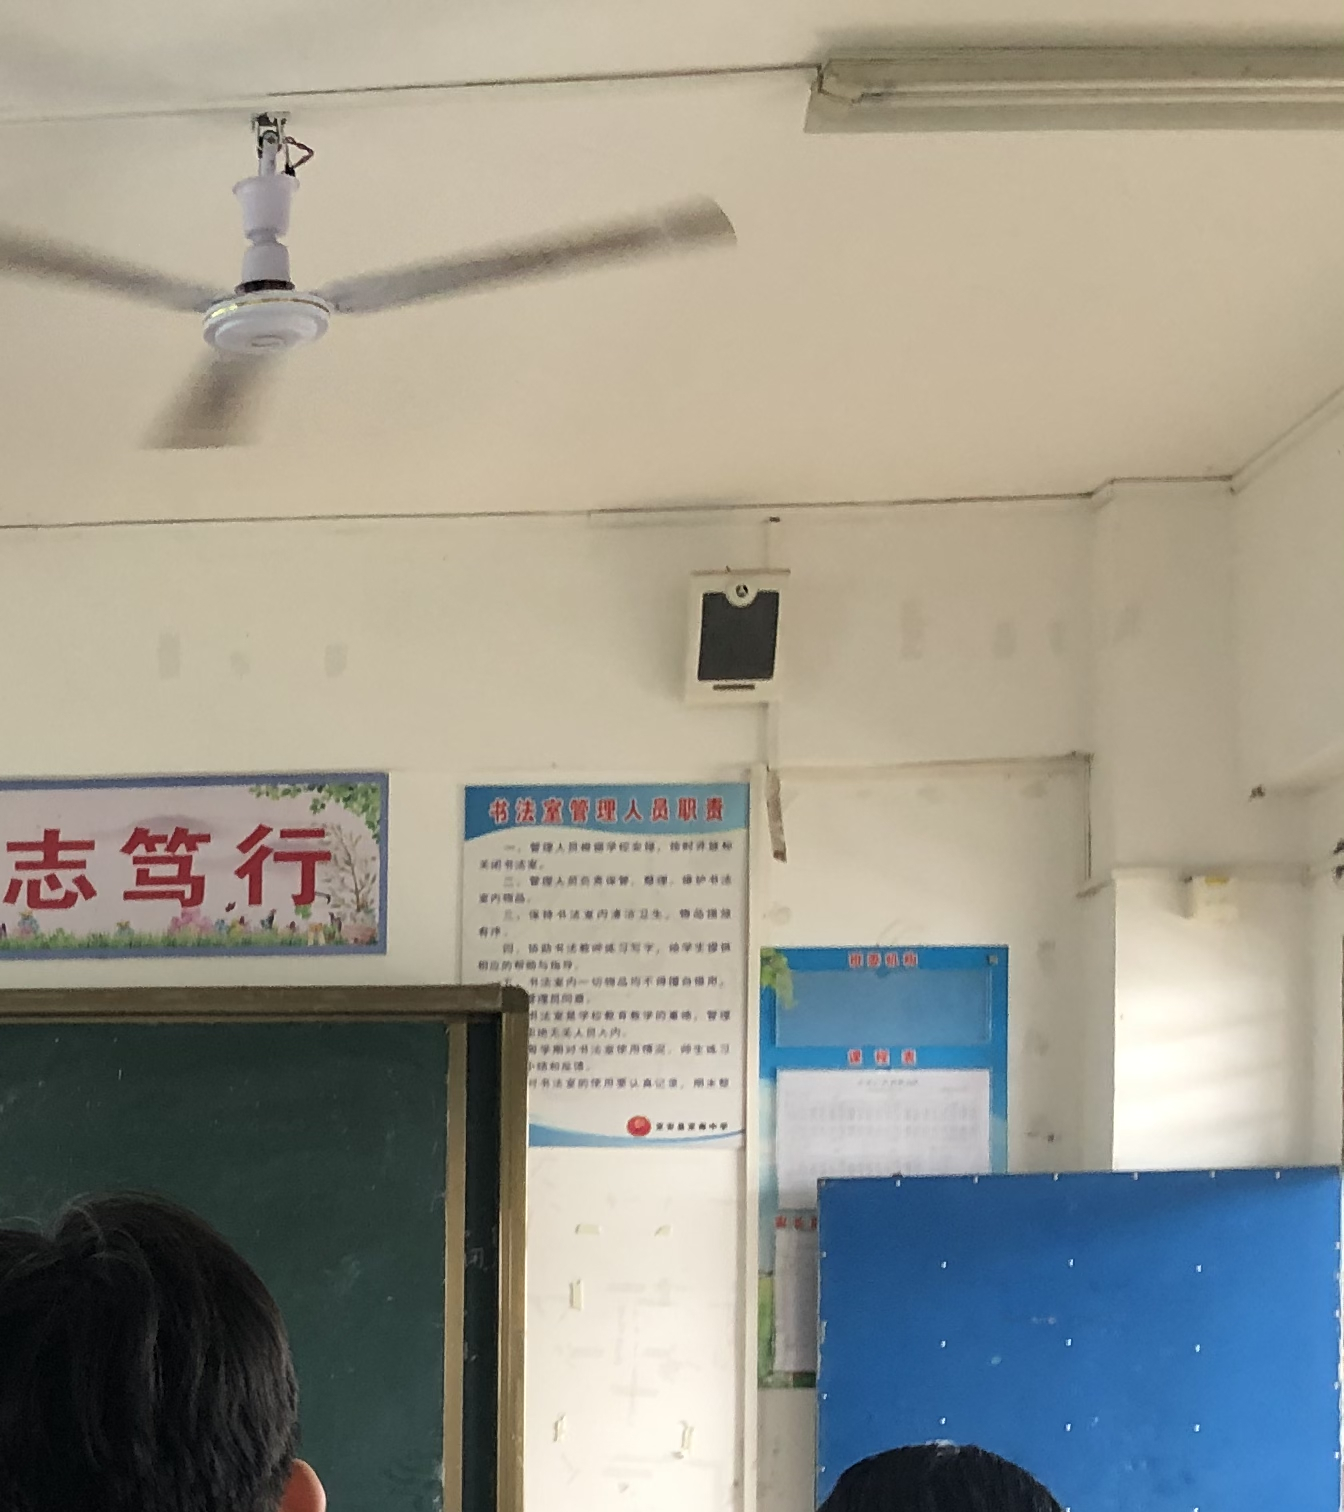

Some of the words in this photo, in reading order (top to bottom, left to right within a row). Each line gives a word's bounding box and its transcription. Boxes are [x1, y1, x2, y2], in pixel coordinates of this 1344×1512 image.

[489, 797, 724, 824] 书法室管理人员职责
